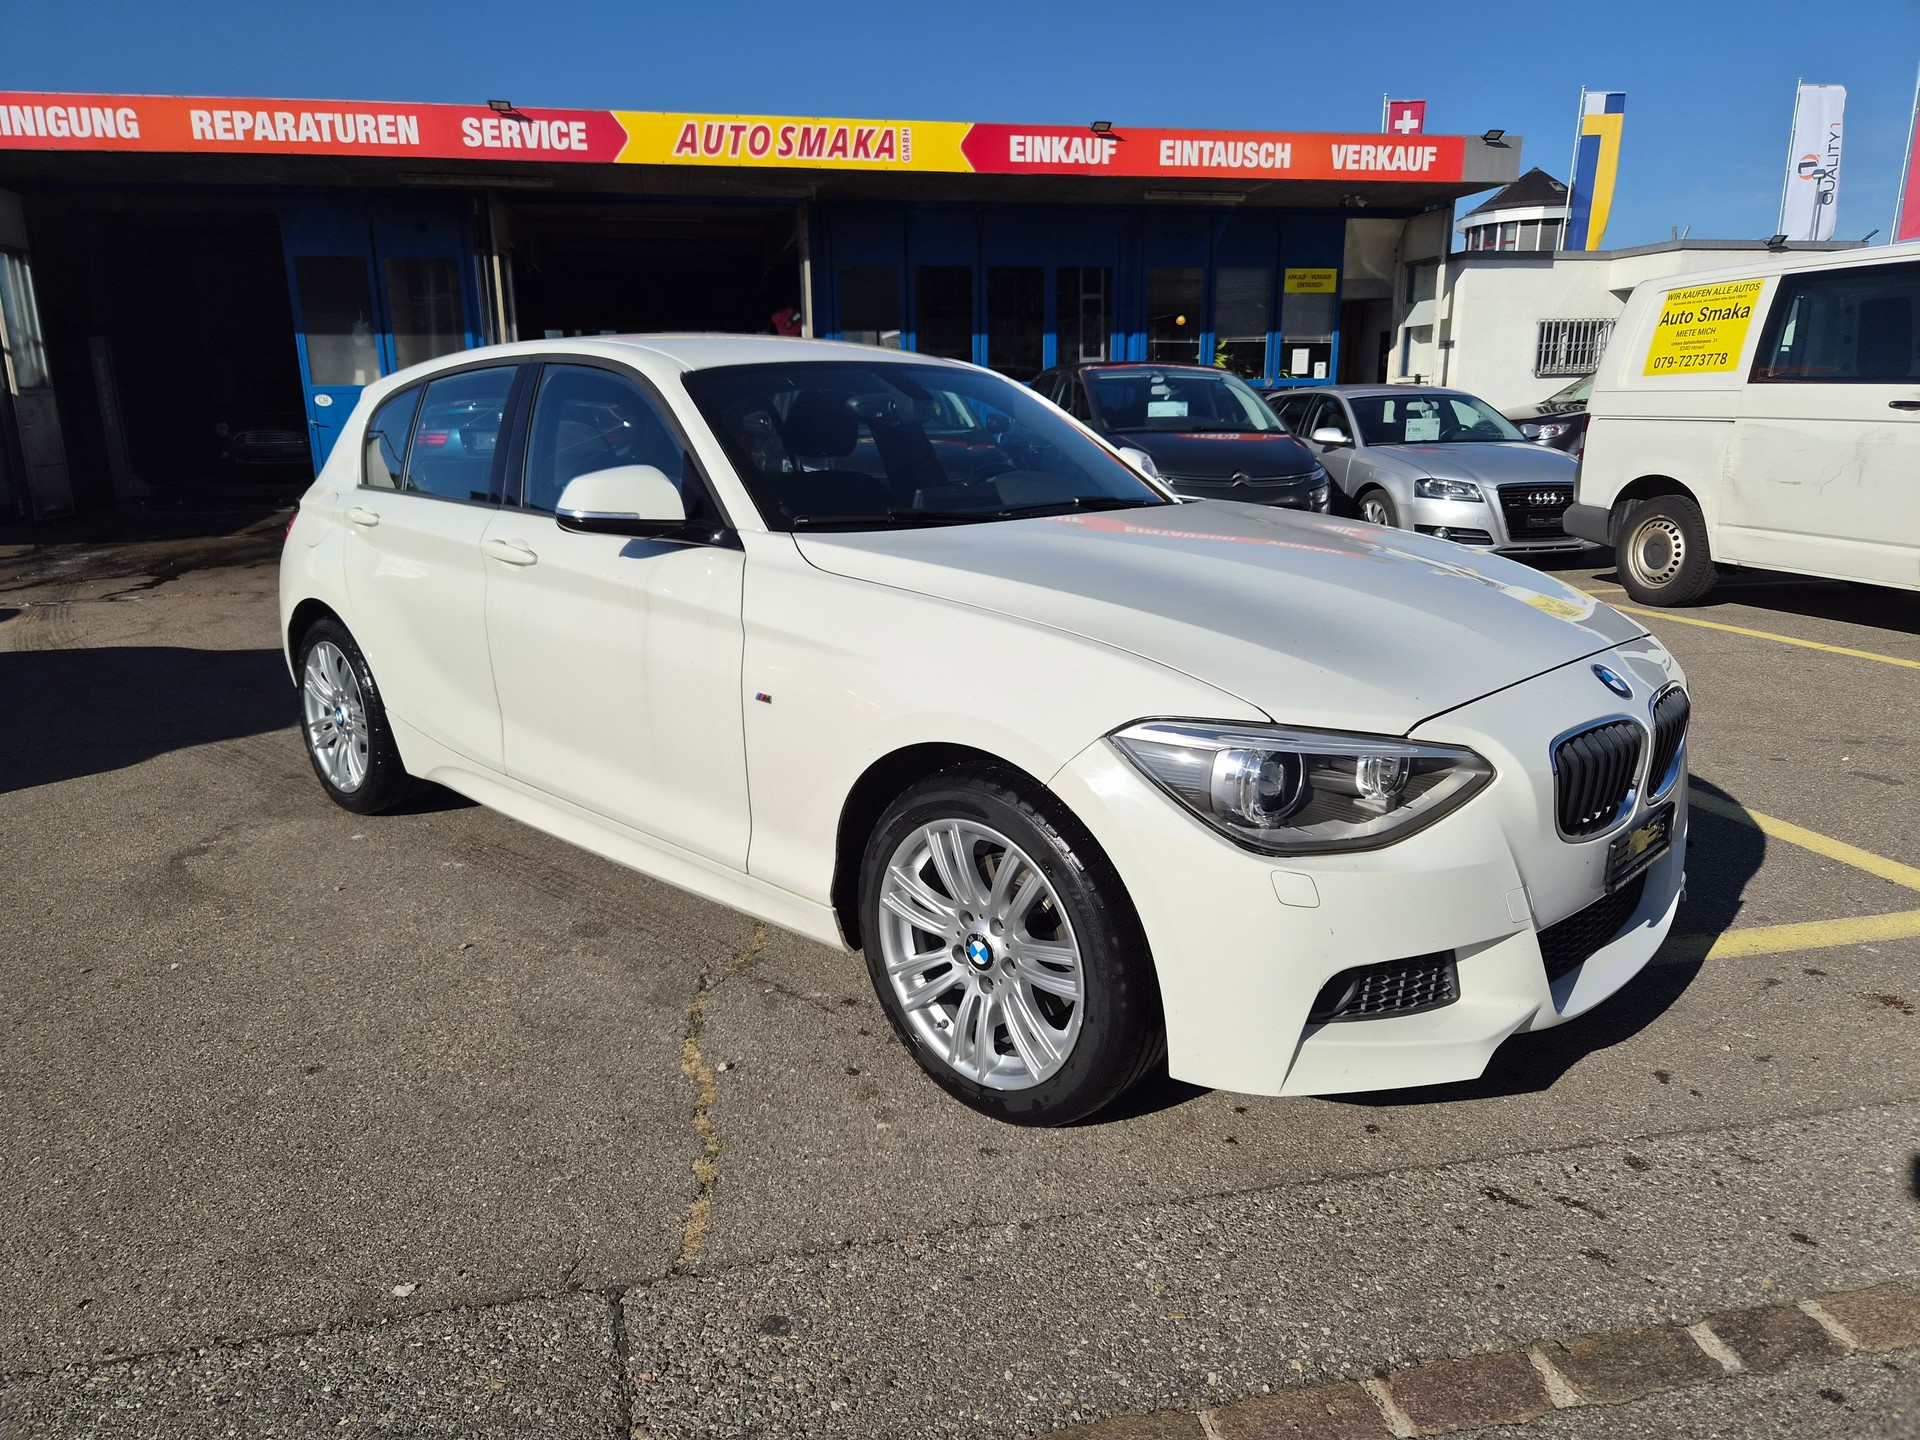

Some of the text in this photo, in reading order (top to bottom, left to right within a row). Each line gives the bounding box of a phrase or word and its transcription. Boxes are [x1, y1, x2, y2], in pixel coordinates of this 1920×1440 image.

[190, 109, 419, 144] REPARATUREN
[462, 117, 587, 150] SERVICE
[1009, 135, 1117, 165] EINKAUF
[1159, 139, 1292, 169] EINTAUSCH
[1331, 144, 1438, 172] VERKAUF
[1822, 131, 1841, 206] QUALITY
[1667, 282, 1761, 301] WIR KAUFEN ALLE AUTOS
[1658, 302, 1751, 327] Auto Smaka
[1675, 326, 1717, 338] MIETE MICH
[1653, 352, 1729, 369] 079-7273778
